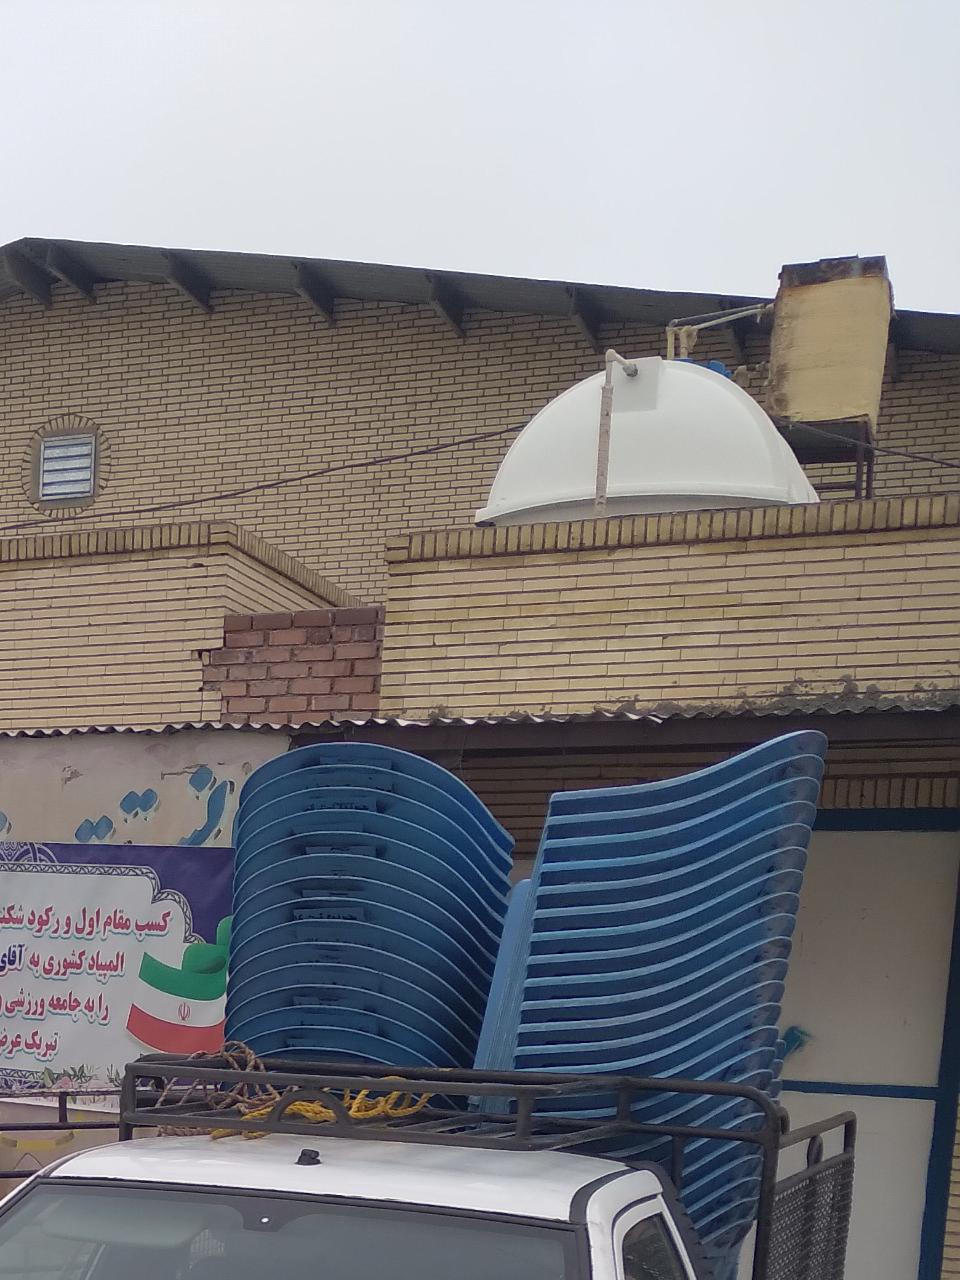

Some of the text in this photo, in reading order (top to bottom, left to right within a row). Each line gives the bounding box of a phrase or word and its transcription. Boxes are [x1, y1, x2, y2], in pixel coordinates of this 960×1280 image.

[28, 905, 60, 935] رکود
[63, 915, 71, 934] و
[75, 906, 101, 937] اول
[103, 907, 131, 937] مقام
[134, 909, 171, 937] کسب
[29, 952, 40, 974] به
[43, 949, 86, 976] کشوری
[88, 950, 125, 978] المپیاد
[5, 987, 46, 1017] ورزشی
[48, 990, 81, 1018] جامعه
[84, 996, 95, 1018] به
[98, 992, 109, 1021] را
[25, 1030, 59, 1057] تبریک
